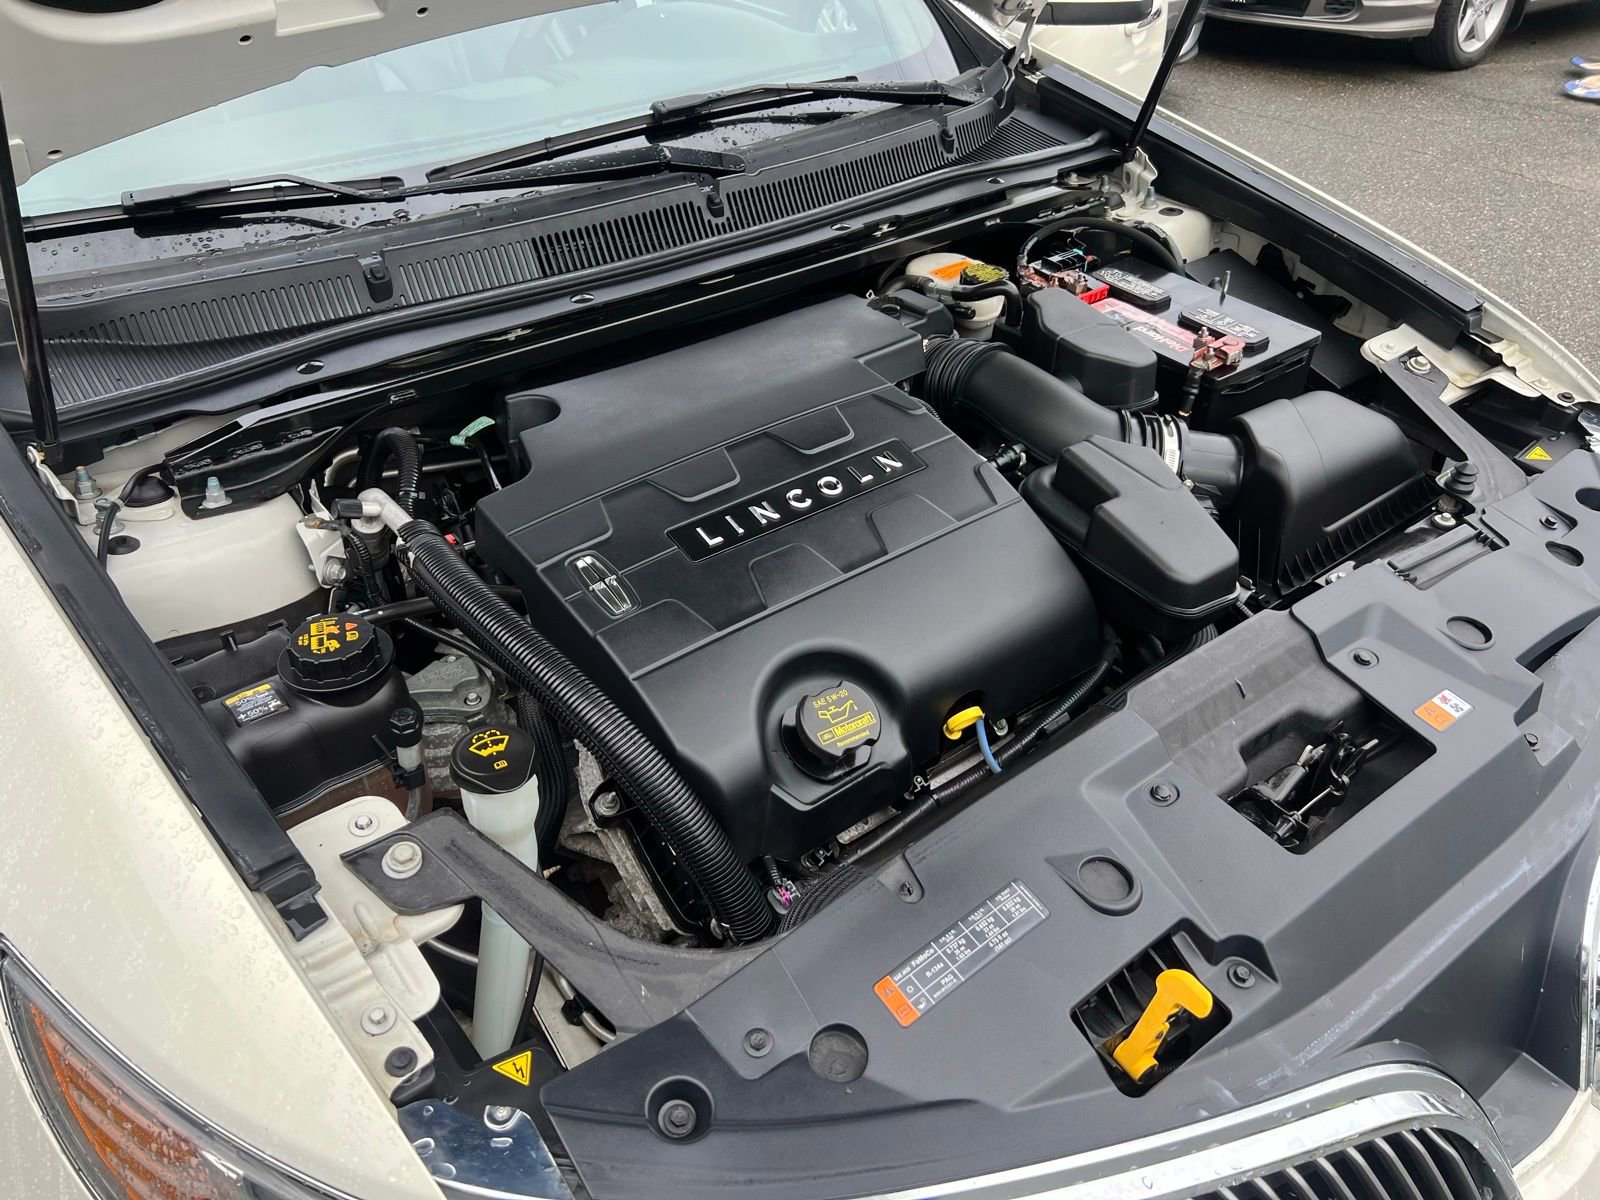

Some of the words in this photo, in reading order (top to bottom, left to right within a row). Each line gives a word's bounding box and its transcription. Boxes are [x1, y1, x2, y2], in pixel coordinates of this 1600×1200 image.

[1133, 326, 1188, 352] DieHard
[696, 451, 903, 547] LINCOLN
[812, 698, 826, 708] SAE
[826, 689, 848, 702] 5W-20
[834, 714, 874, 737] Motorcraft
[911, 948, 934, 967] FoMoCo
[925, 962, 944, 978] R-134a
[940, 974, 954, 986] PAG
